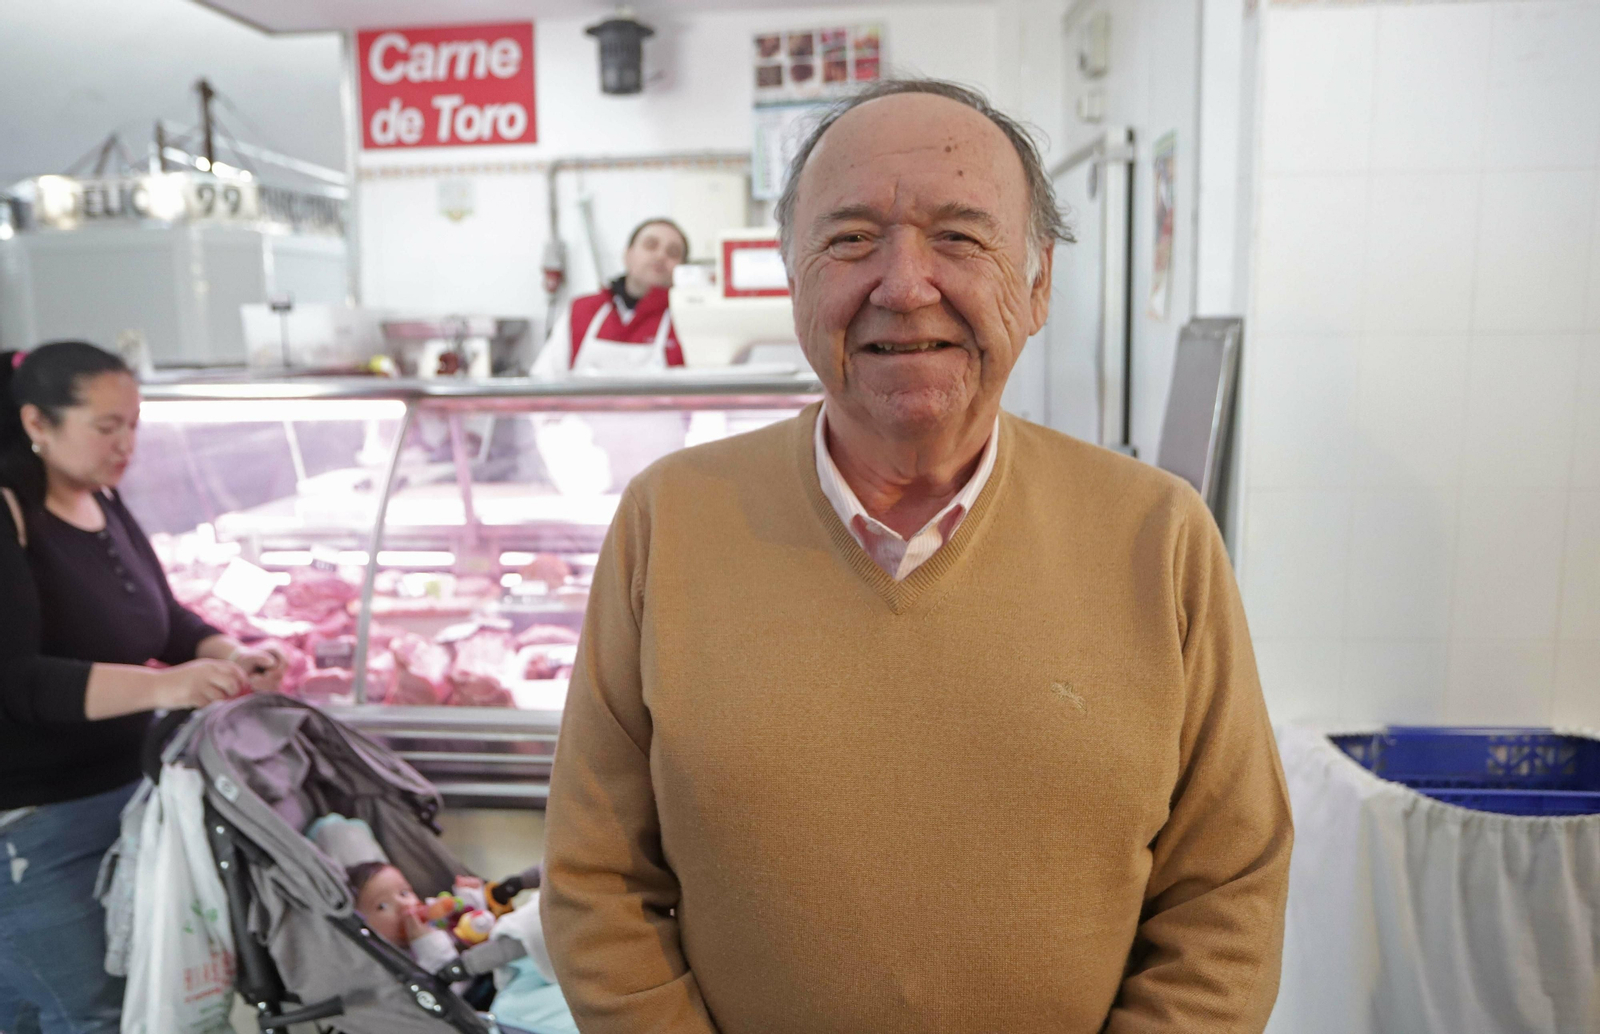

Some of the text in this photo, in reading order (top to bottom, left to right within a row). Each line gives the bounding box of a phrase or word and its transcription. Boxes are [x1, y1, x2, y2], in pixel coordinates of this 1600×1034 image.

[368, 31, 523, 85] Carne
[370, 93, 528, 146] de Toro
